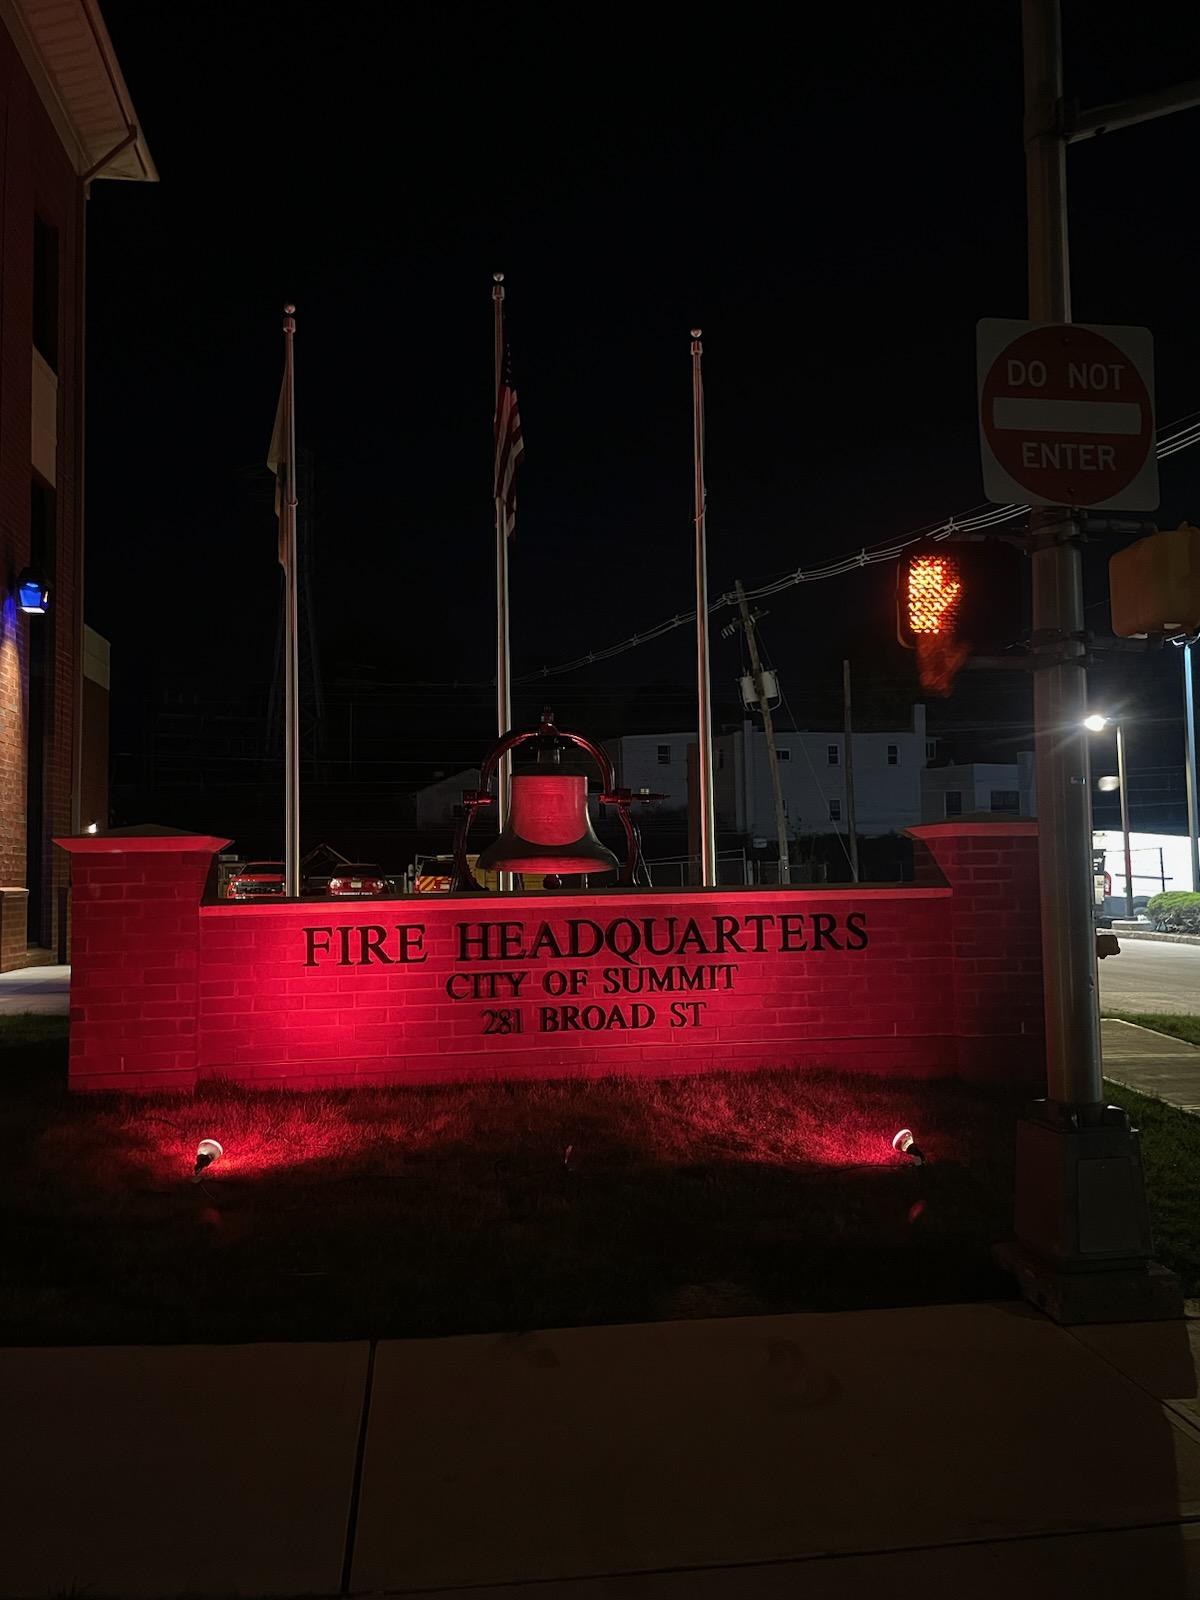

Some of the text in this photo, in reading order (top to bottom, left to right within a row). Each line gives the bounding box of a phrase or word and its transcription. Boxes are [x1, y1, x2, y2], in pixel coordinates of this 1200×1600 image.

[1007, 359, 1125, 390] DO NOT
[1022, 442, 1117, 471] ENTER
[303, 913, 868, 967] FIRE HEADQUARTERS
[446, 963, 739, 1000] CITY OF SUMMIT
[481, 1002, 707, 1035] 281 BROAD ST
